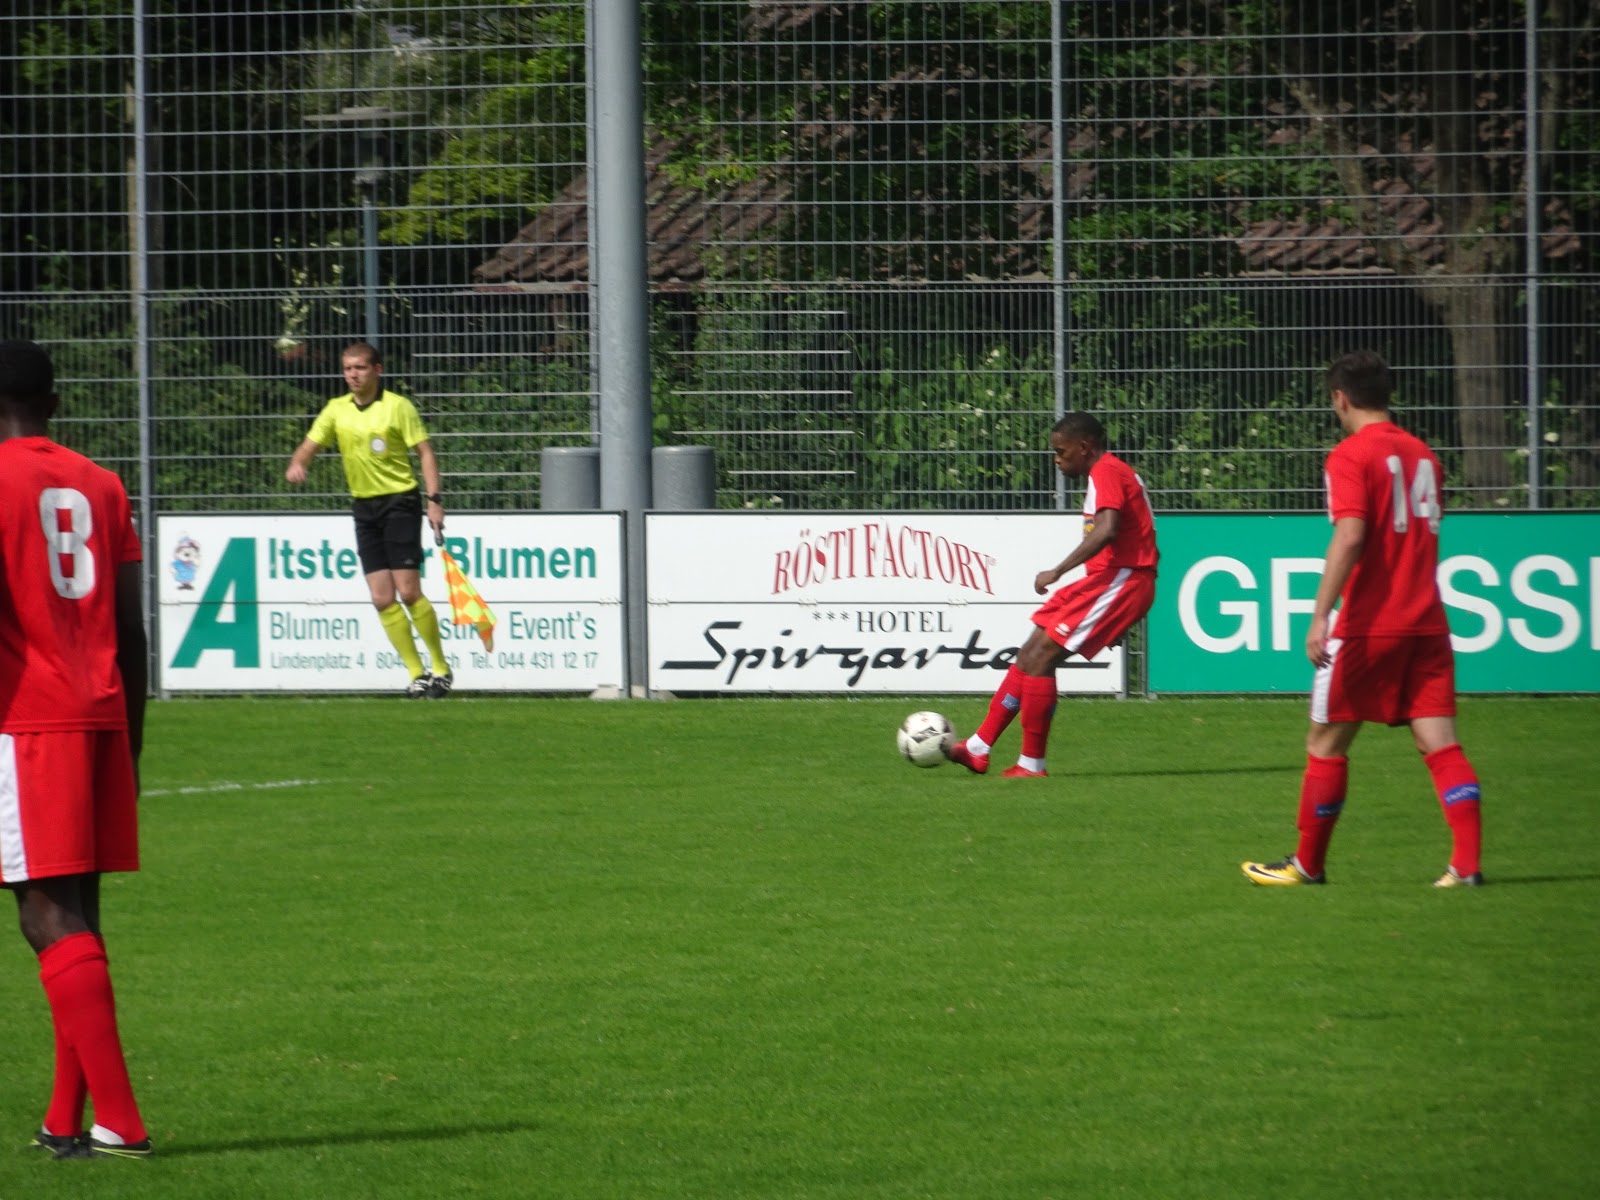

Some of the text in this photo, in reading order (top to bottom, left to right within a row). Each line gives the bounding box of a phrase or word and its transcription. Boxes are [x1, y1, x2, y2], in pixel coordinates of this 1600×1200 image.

[1386, 455, 1440, 534] 14
[39, 487, 95, 599] 8
[444, 536, 596, 579] Blumen
[771, 521, 994, 595] RÖSTI FACTORY
[270, 611, 360, 640] Blumen
[510, 611, 596, 640] Event's
[856, 610, 953, 632] HOTEL
[1178, 555, 1600, 653] GRSS
[271, 652, 351, 674] Lindenplatz
[355, 652, 366, 669] 4
[470, 652, 494, 669] Tel.
[498, 652, 525, 669] 044
[530, 652, 555, 669] 431
[562, 652, 578, 669] 12
[583, 652, 599, 669] 17
[660, 621, 1110, 687] Spirgarte
